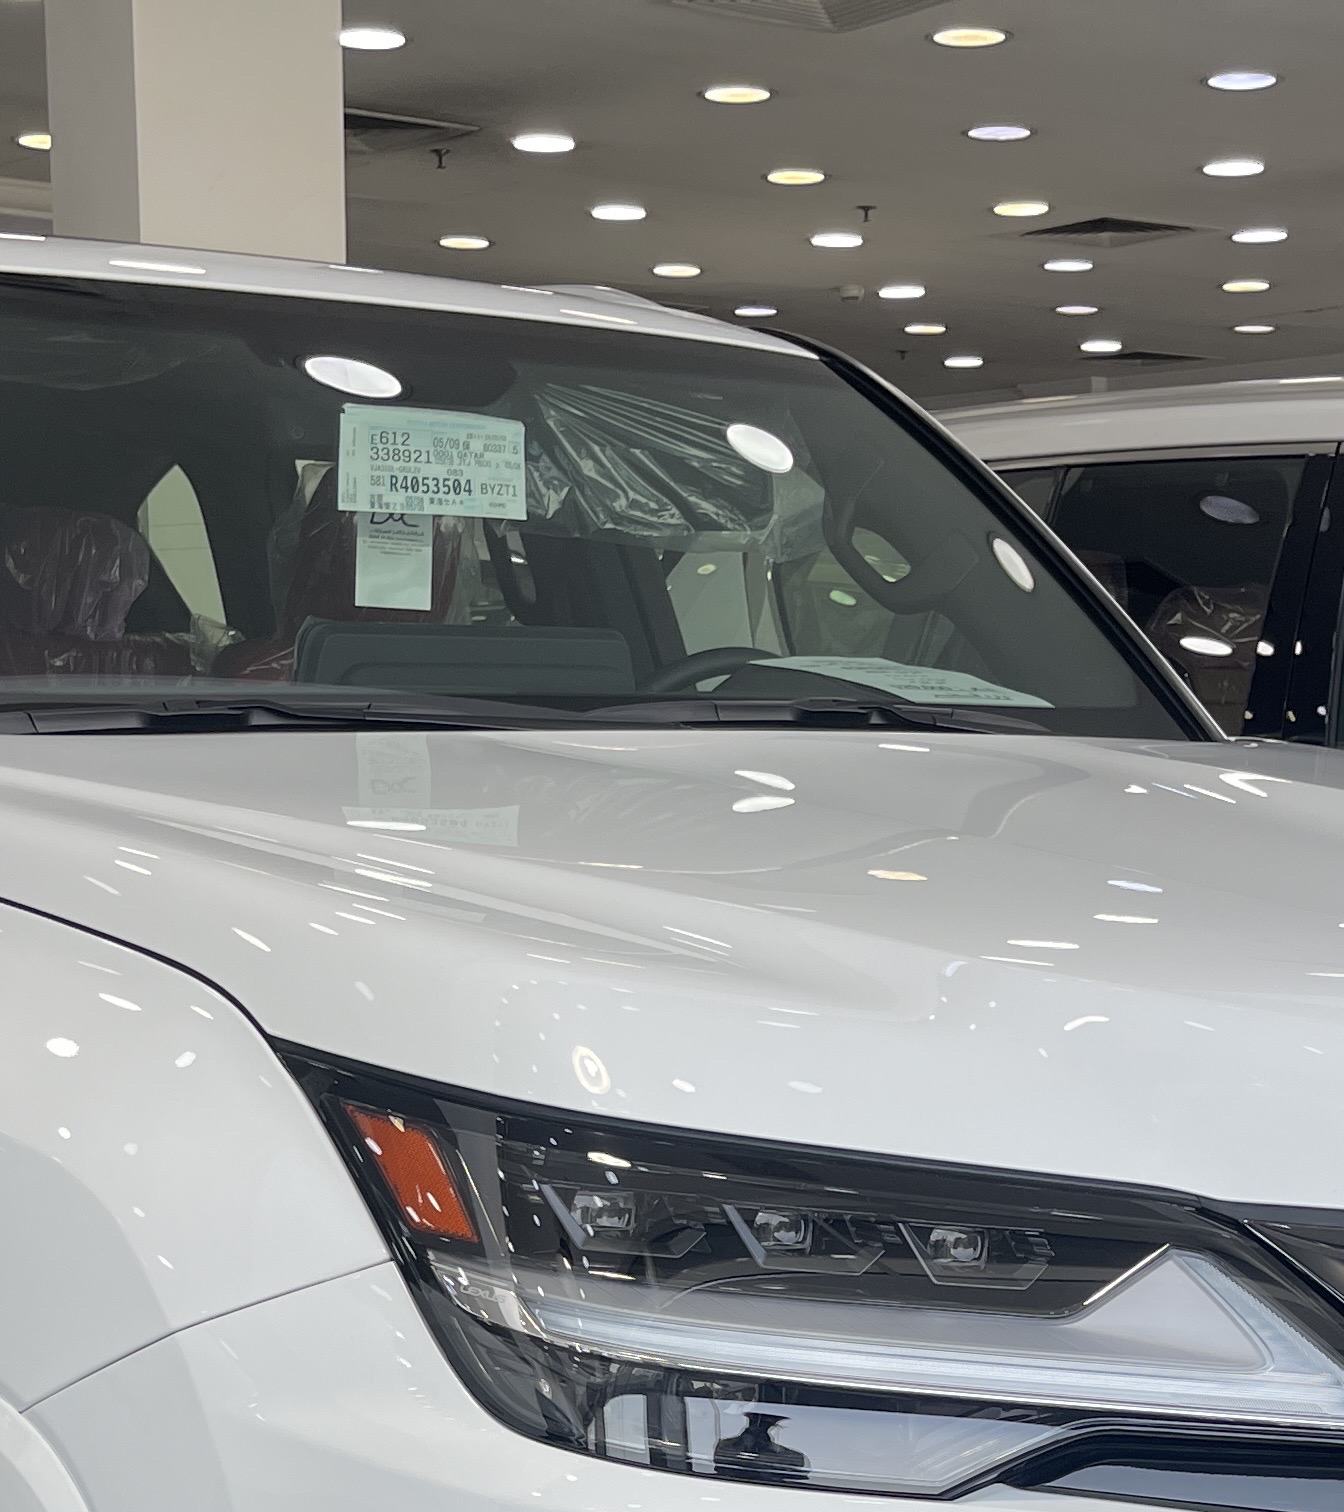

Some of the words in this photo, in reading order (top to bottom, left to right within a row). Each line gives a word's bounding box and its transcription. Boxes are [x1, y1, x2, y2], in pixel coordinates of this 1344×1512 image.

[369, 446, 432, 464] 338921
[389, 474, 473, 497] R4053504
[480, 482, 518, 497] BYZT1
